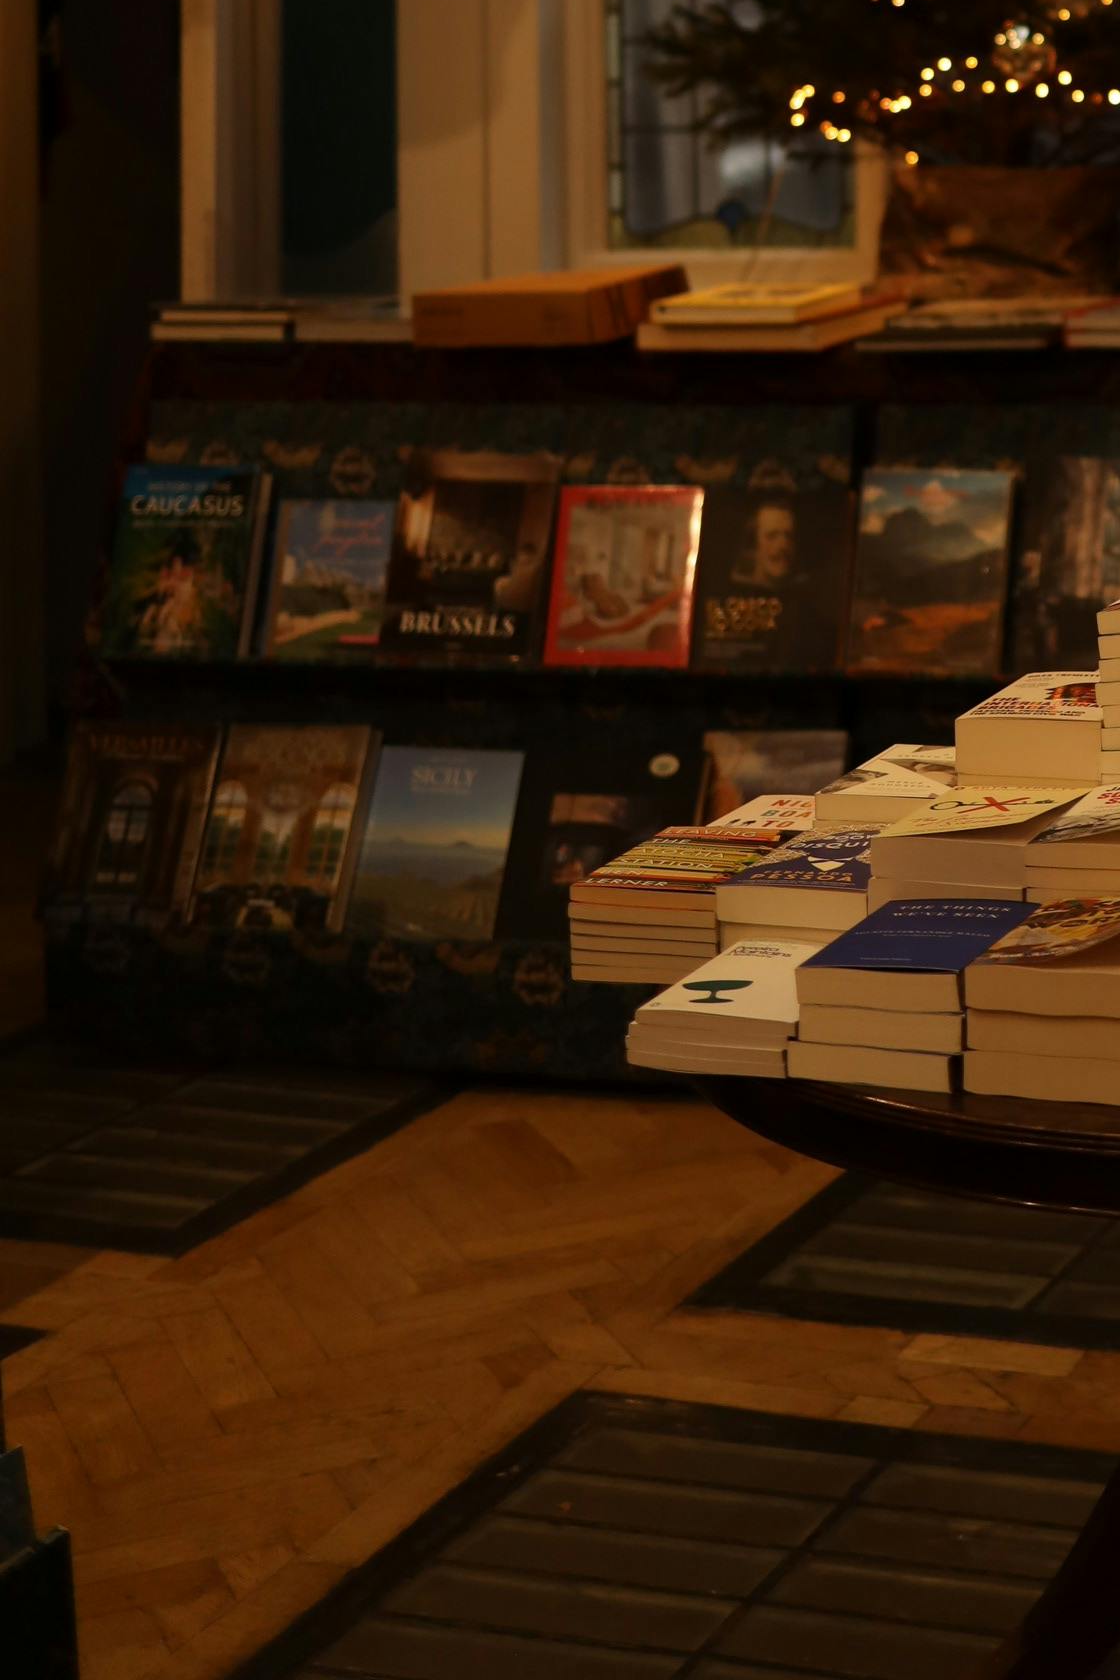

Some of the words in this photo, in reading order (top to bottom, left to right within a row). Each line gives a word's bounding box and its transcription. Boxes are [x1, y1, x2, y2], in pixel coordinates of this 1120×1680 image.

[130, 494, 244, 518] CAUCASUS
[400, 608, 516, 638] BRUSSELS
[409, 766, 479, 784] SICILY
[771, 799, 815, 807] NIG
[760, 809, 813, 818] BOA
[762, 820, 794, 828] TO
[664, 828, 757, 837] LEAVING
[790, 841, 870, 850] DISQUI
[638, 848, 725, 858] ATOCHA
[618, 858, 713, 869] STATION
[751, 873, 853, 882] PESSOA
[584, 878, 669, 887] LERNER
